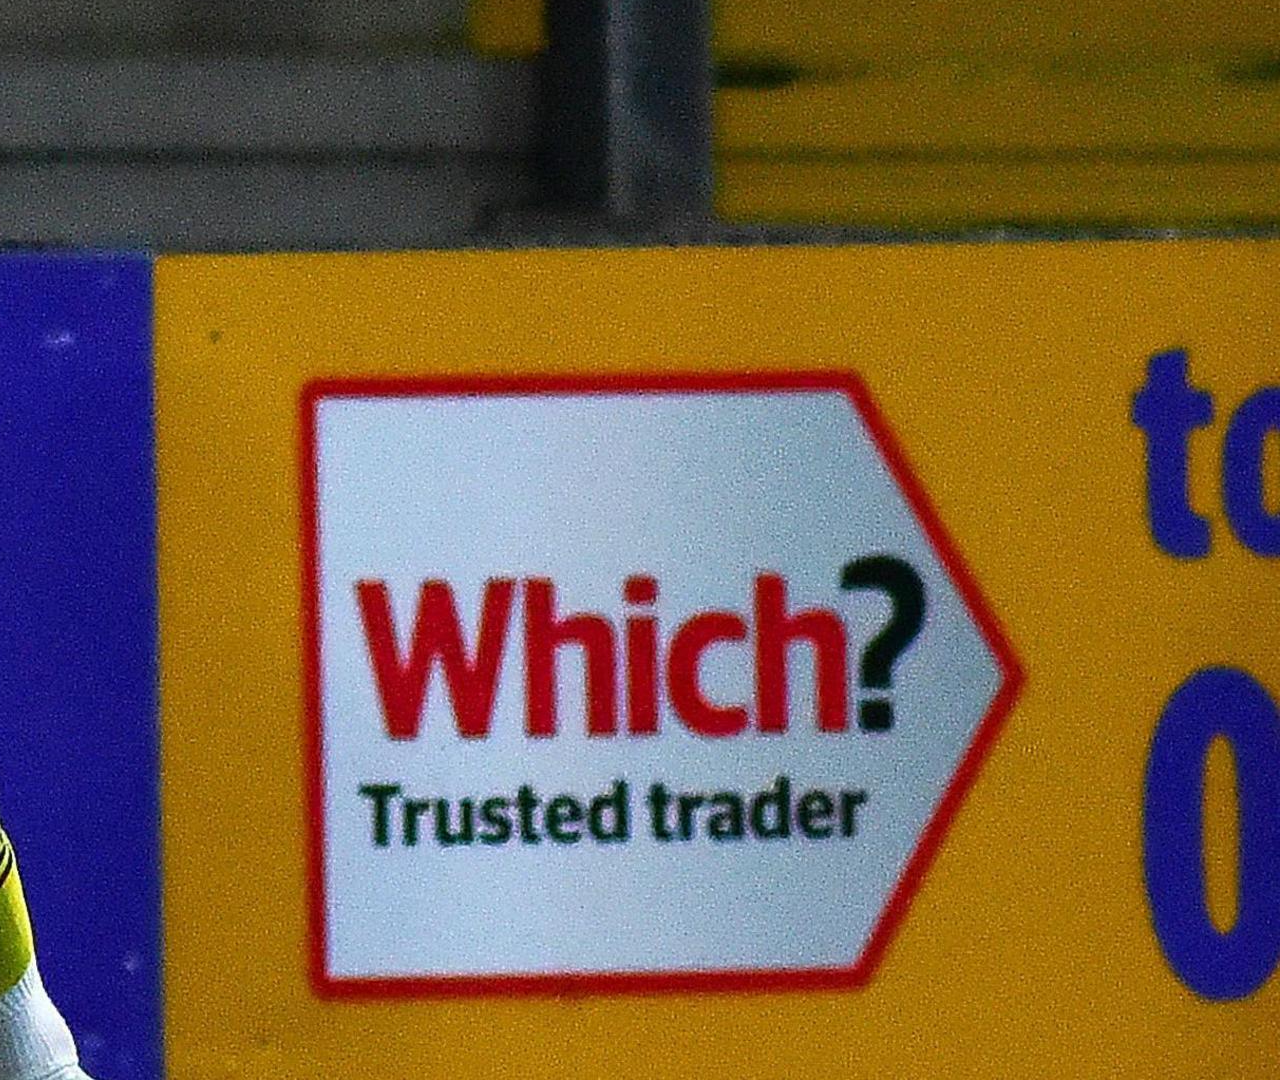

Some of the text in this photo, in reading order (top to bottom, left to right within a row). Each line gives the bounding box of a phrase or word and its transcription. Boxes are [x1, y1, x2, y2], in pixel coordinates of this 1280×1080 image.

[354, 553, 928, 742] Which?
[357, 775, 869, 849] Trusted trader
